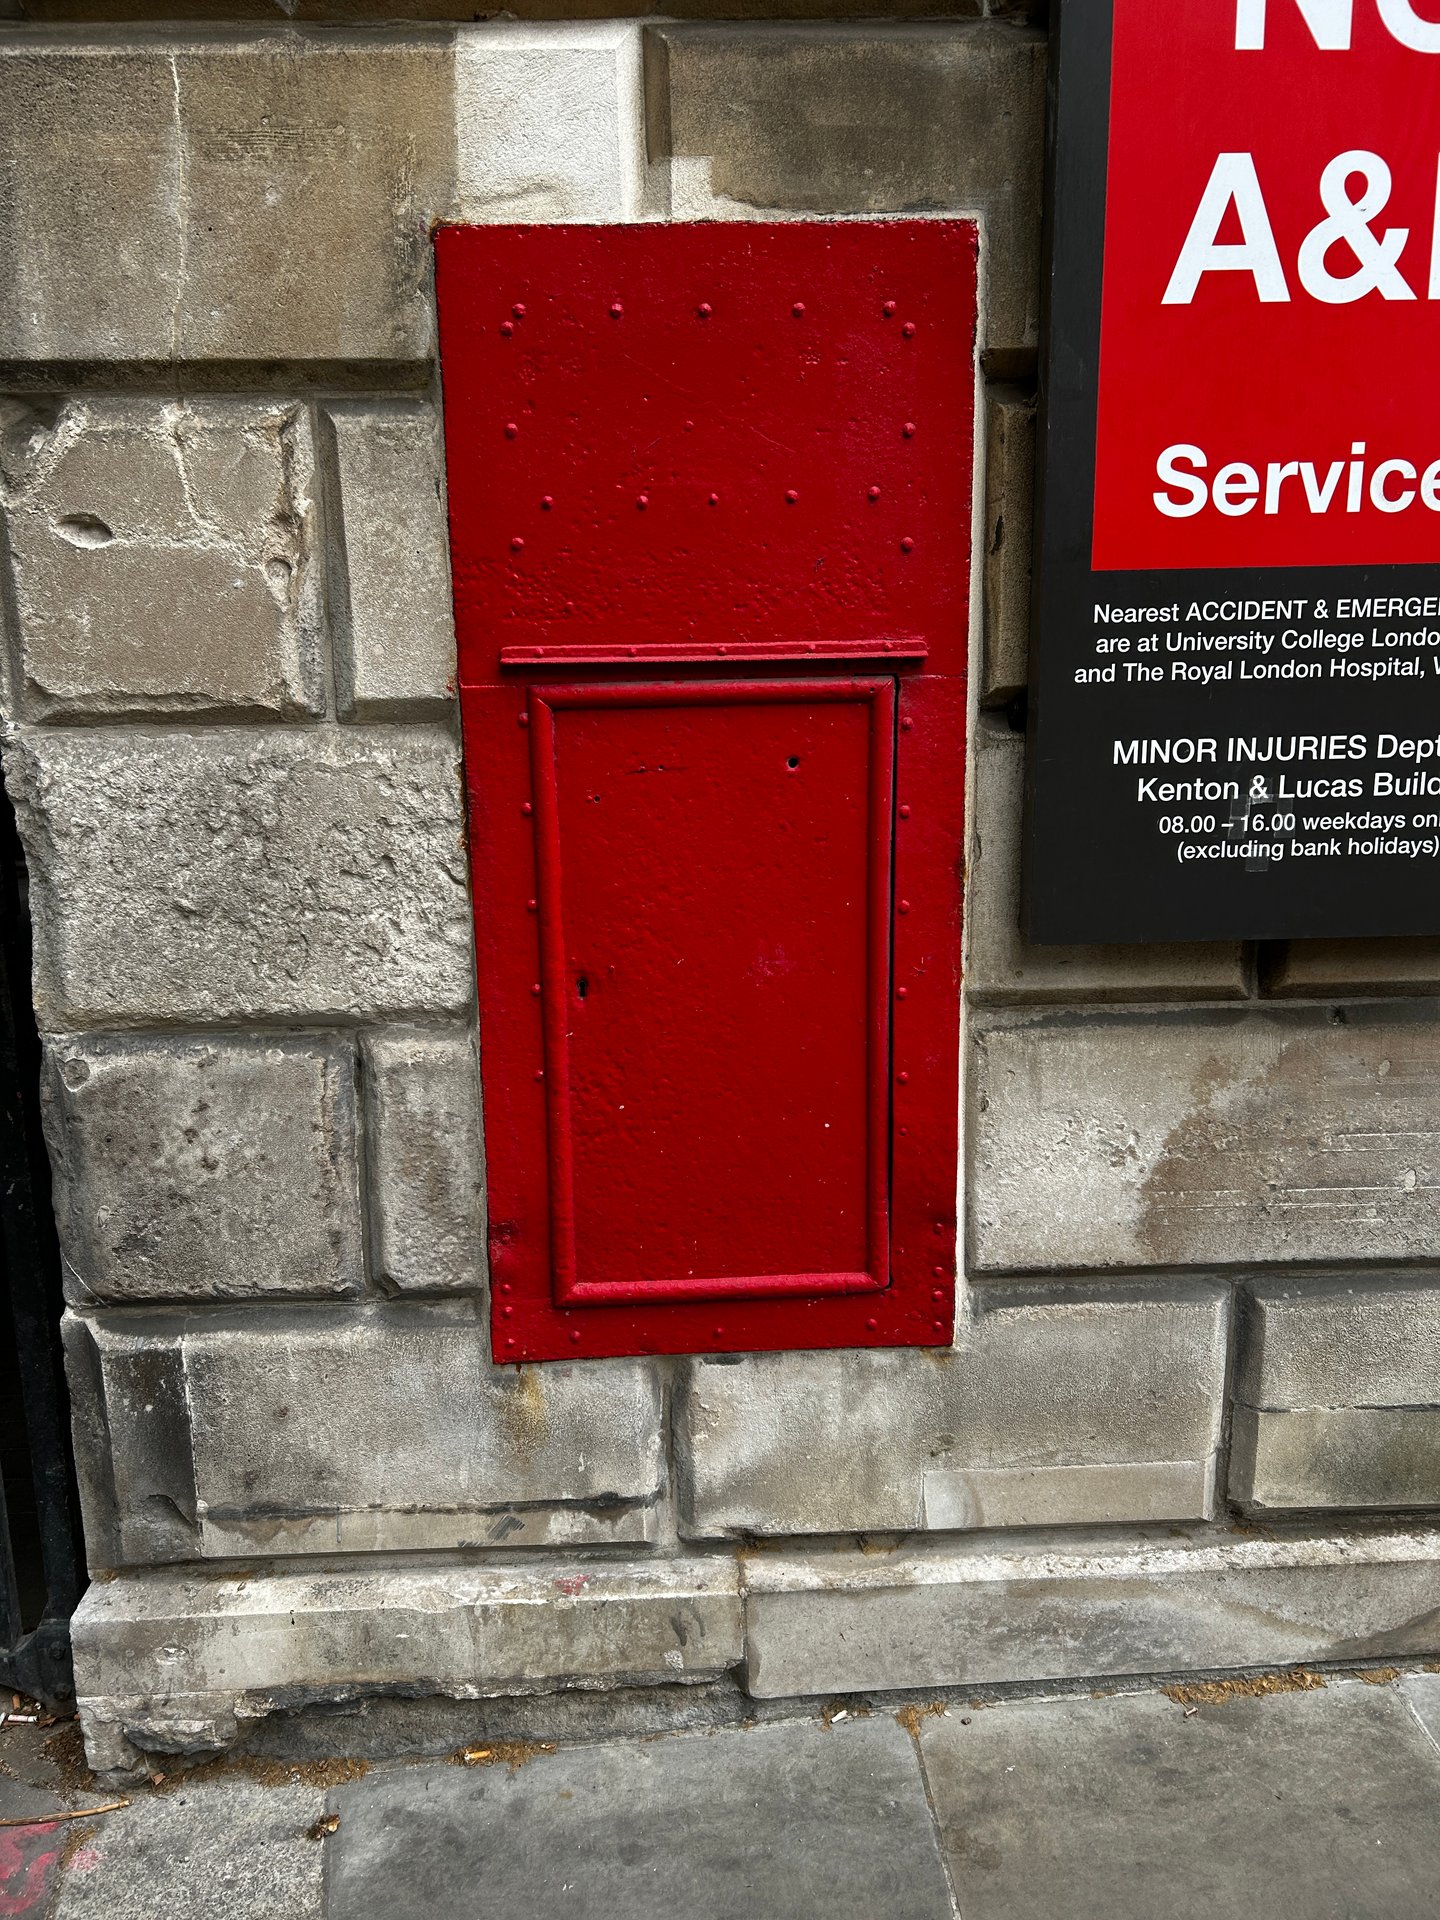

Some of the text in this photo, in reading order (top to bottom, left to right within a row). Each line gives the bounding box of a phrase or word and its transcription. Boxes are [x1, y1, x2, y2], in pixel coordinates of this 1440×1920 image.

[1161, 150, 1440, 304] A&
[1094, 597, 1440, 624] Nearest ACCIDENT & EMERGE
[1095, 637, 1130, 653] are
[1138, 634, 1159, 653] at
[1166, 628, 1275, 654] University
[1282, 629, 1364, 653] College
[1074, 664, 1116, 684] and
[1123, 662, 1164, 683] The
[1172, 661, 1233, 685] Royal
[1240, 659, 1323, 680] London
[1330, 657, 1425, 679] Hospital,
[1113, 738, 1217, 765] MINOR
[1228, 735, 1367, 762] INJURIES
[1137, 777, 1239, 802] Kenton
[1248, 775, 1270, 801] &
[1279, 774, 1364, 799] Lucas
[1158, 815, 1216, 834] 08.00
[1241, 812, 1296, 832] 16.00
[1303, 811, 1406, 833] weekdays
[1177, 836, 1440, 864] (excluding bank holidays)
